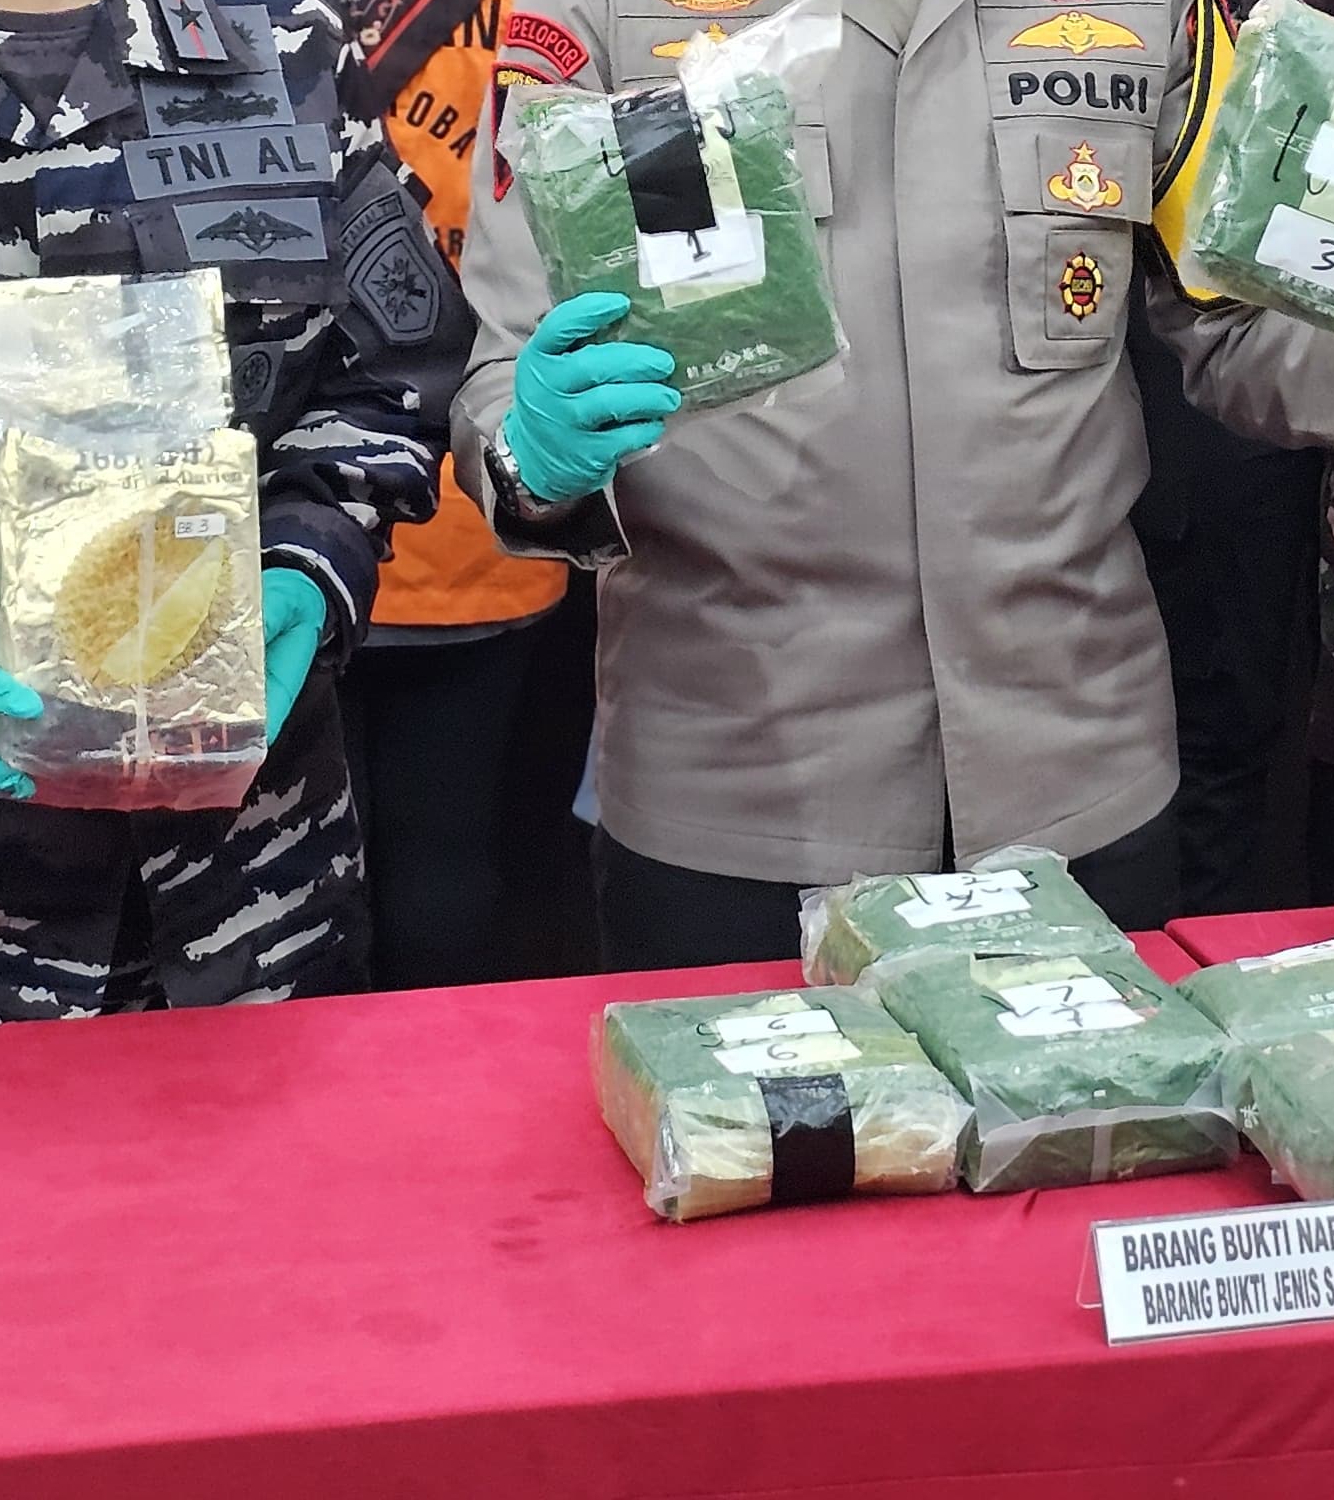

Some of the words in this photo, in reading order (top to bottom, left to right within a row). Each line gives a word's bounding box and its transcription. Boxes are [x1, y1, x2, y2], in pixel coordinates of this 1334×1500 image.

[511, 17, 579, 67] PELOPOR
[1008, 69, 1148, 114] POLRI
[146, 141, 231, 187] TNI
[258, 135, 317, 176] AL
[198, 518, 210, 534] 3
[766, 1042, 799, 1061] 6
[1122, 1226, 1218, 1273] BARANG
[1221, 1219, 1292, 1262] BUKTI
[1142, 1277, 1214, 1326] BARANG
[1216, 1271, 1270, 1318] BUKTI
[1272, 1266, 1321, 1312] JENIS
